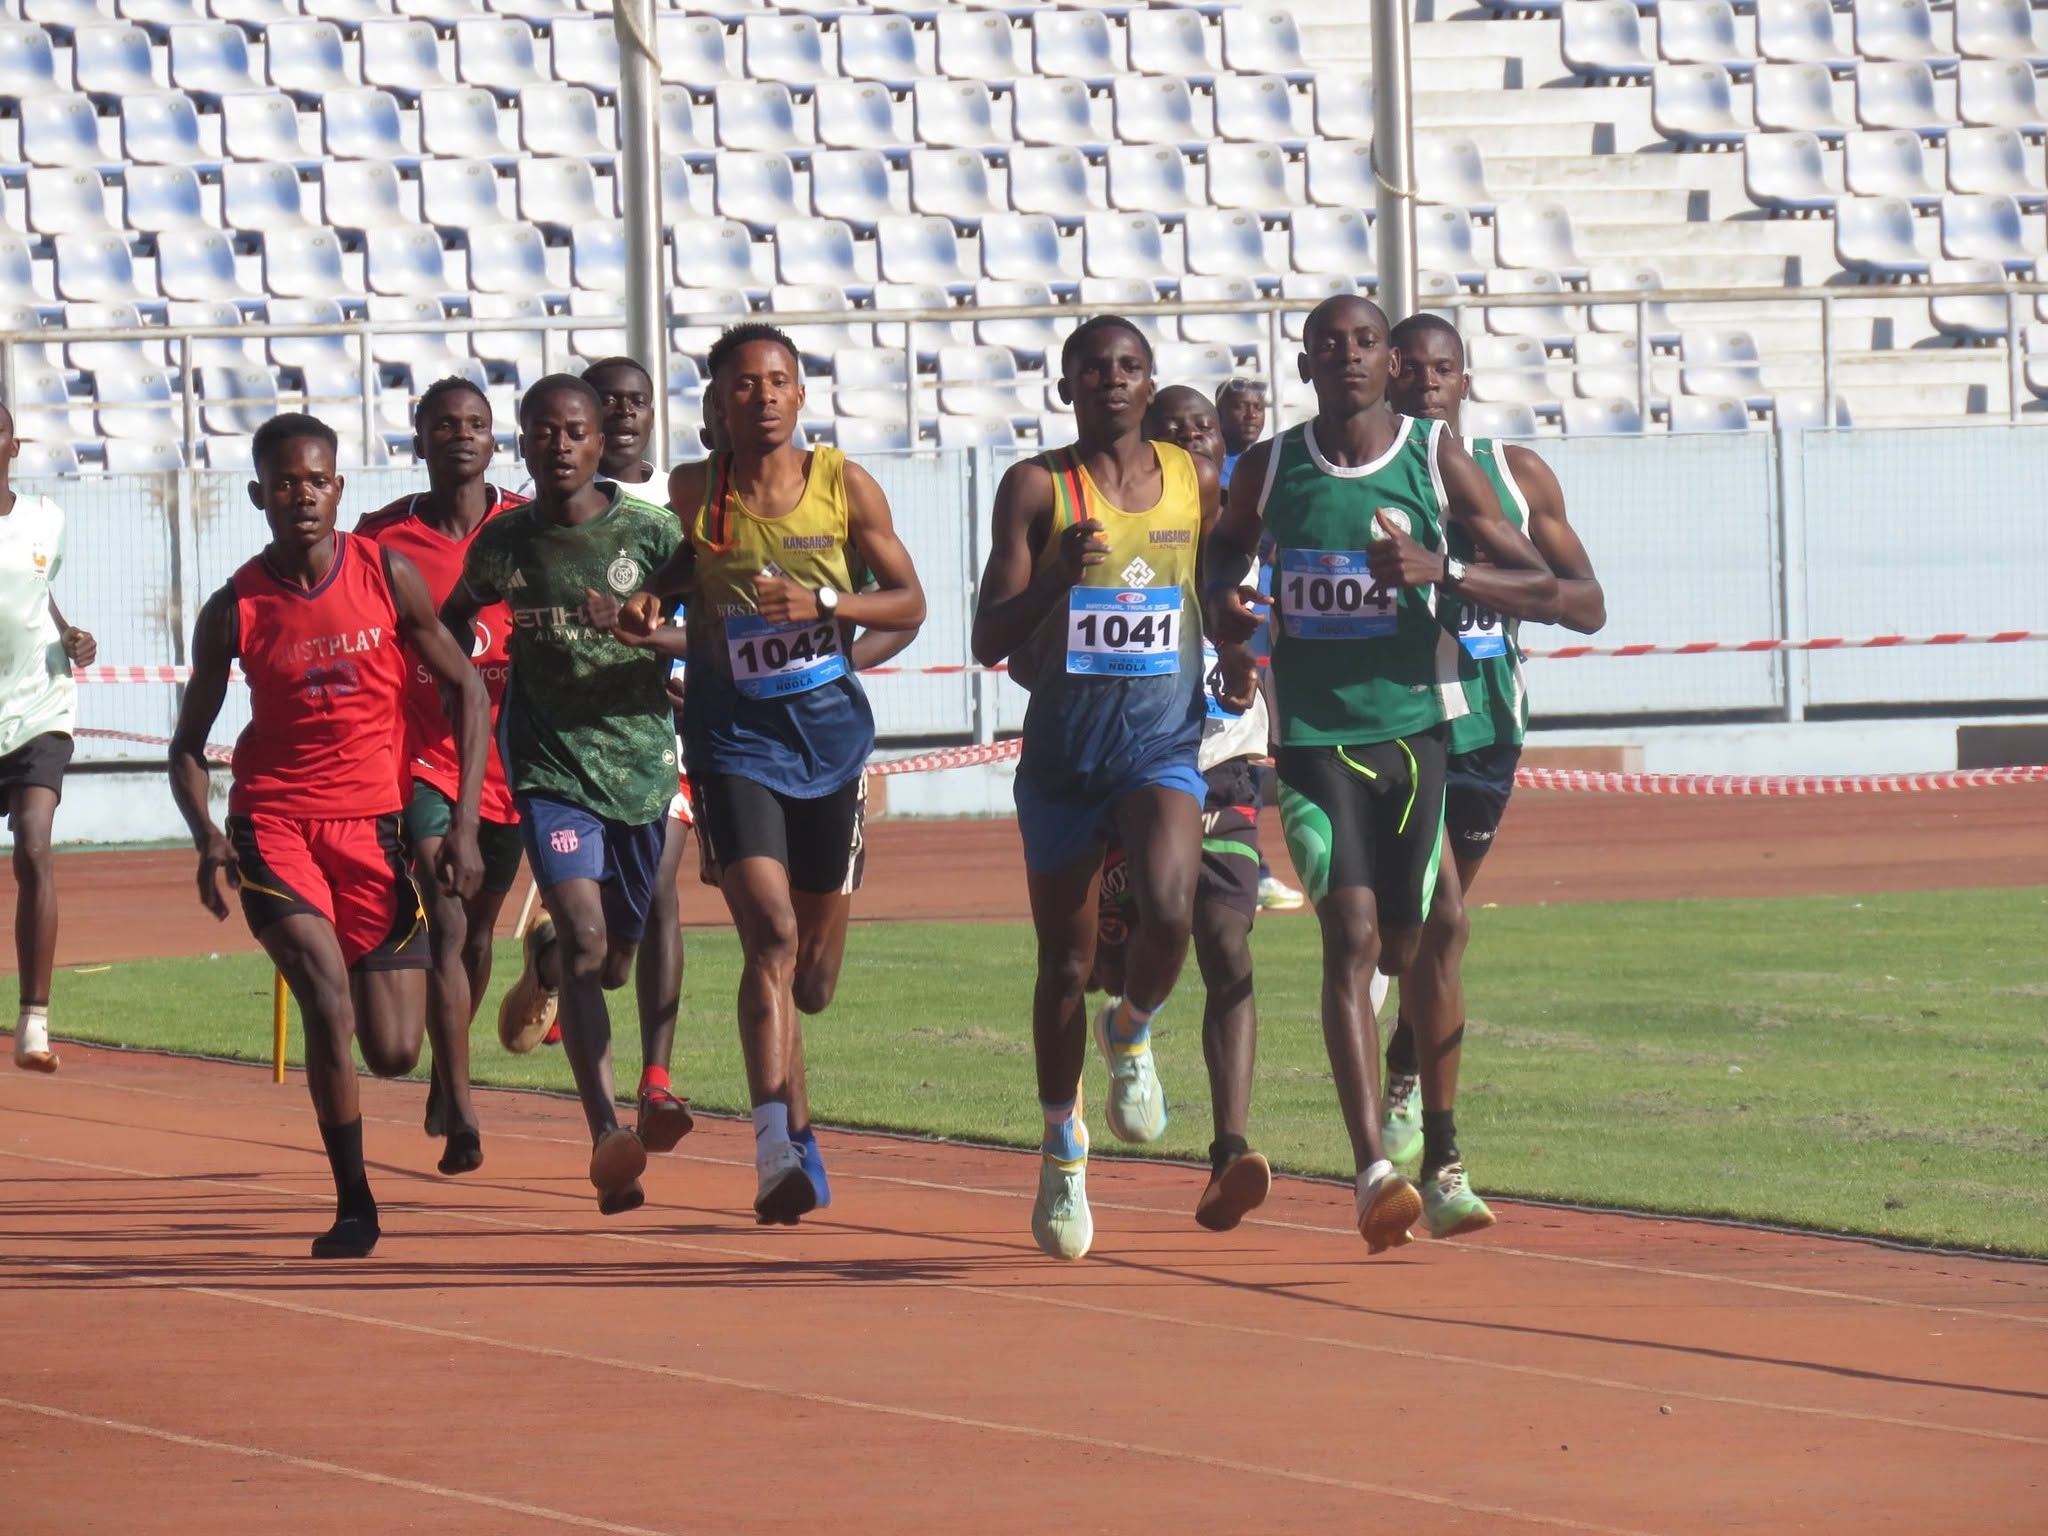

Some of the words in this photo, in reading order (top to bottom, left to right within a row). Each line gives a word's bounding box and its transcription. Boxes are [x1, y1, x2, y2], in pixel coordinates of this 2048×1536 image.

[1288, 576, 1392, 612] 1004
[513, 607, 588, 628] ETIH
[1077, 614, 1171, 648] 1041
[280, 627, 382, 664] USTPLAY
[534, 629, 615, 641] AIRWA
[737, 625, 838, 673] 1042
[1108, 663, 1147, 671] NDOLA
[776, 677, 814, 692] NDOLA
